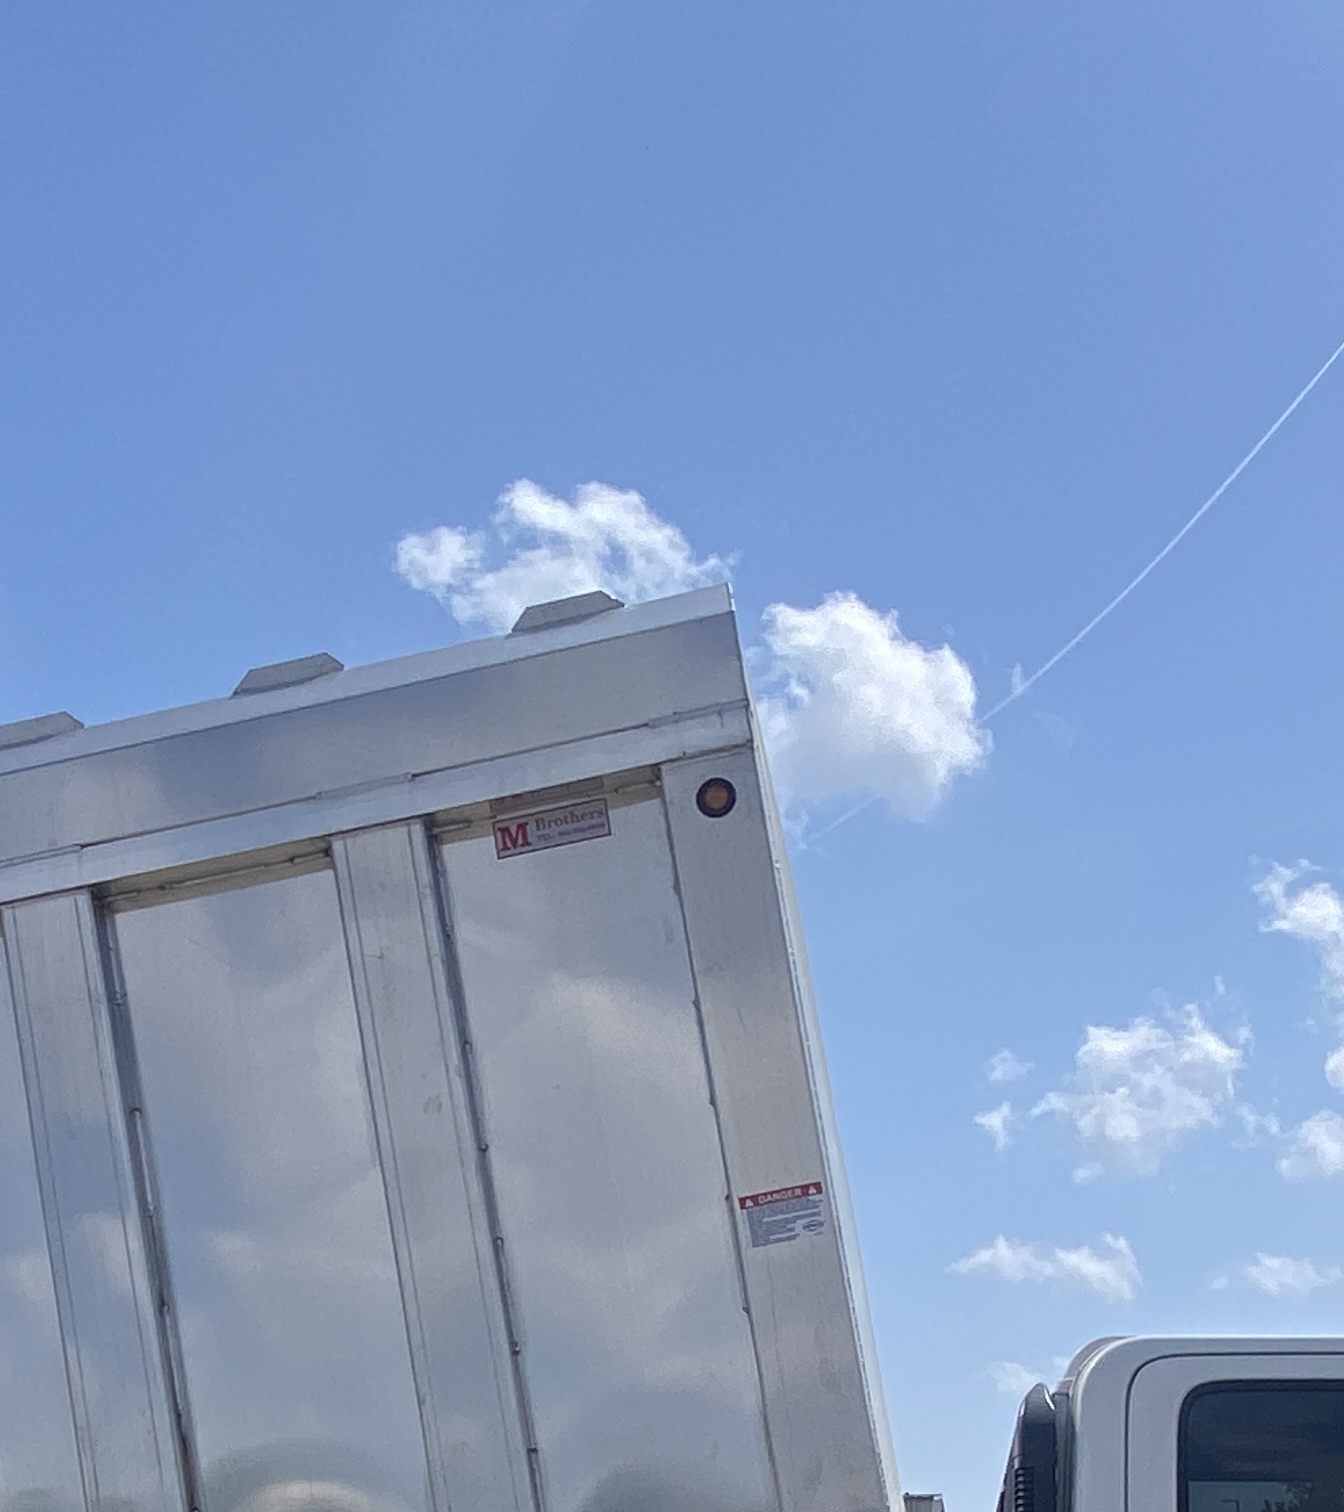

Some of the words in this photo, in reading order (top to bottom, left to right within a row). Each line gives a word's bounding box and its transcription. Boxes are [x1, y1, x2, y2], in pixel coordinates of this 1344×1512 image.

[497, 821, 533, 850] M
[534, 807, 604, 832] Brothers
[758, 1187, 803, 1204] DANGER
